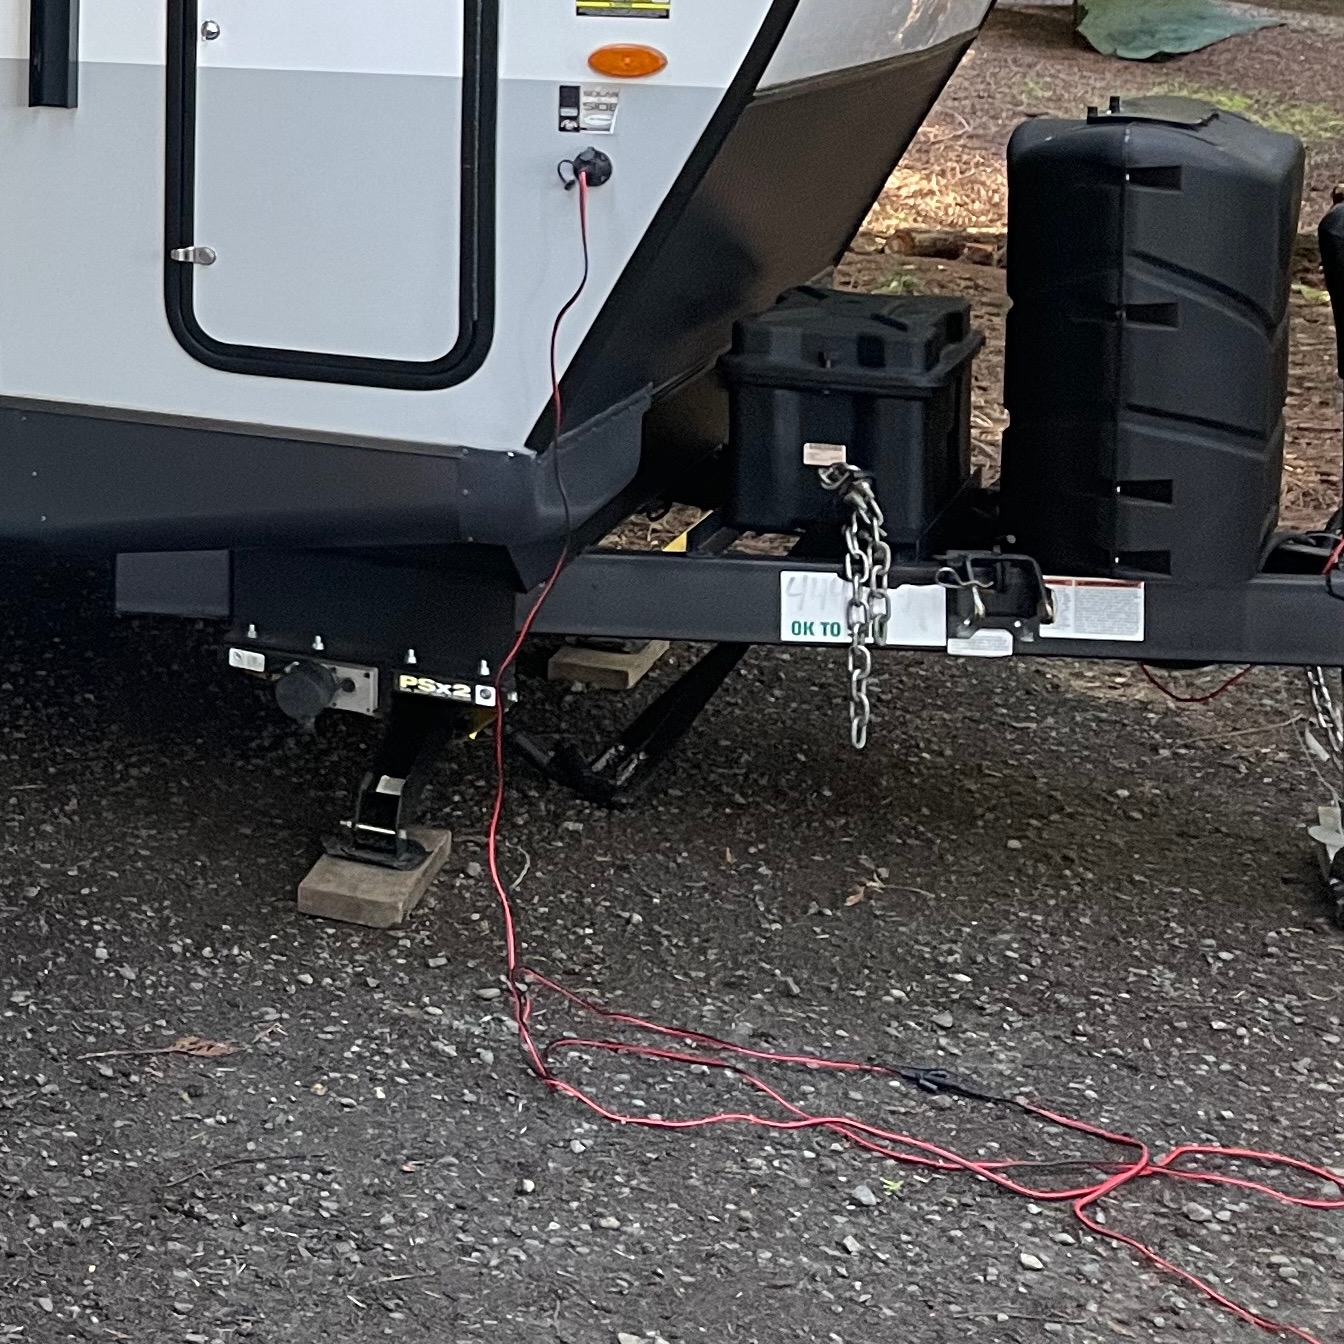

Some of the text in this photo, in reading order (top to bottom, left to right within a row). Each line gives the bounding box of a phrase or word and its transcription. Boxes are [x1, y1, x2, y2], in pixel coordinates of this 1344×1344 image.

[791, 620, 841, 638] OK TO
[400, 675, 471, 698] PSx2
